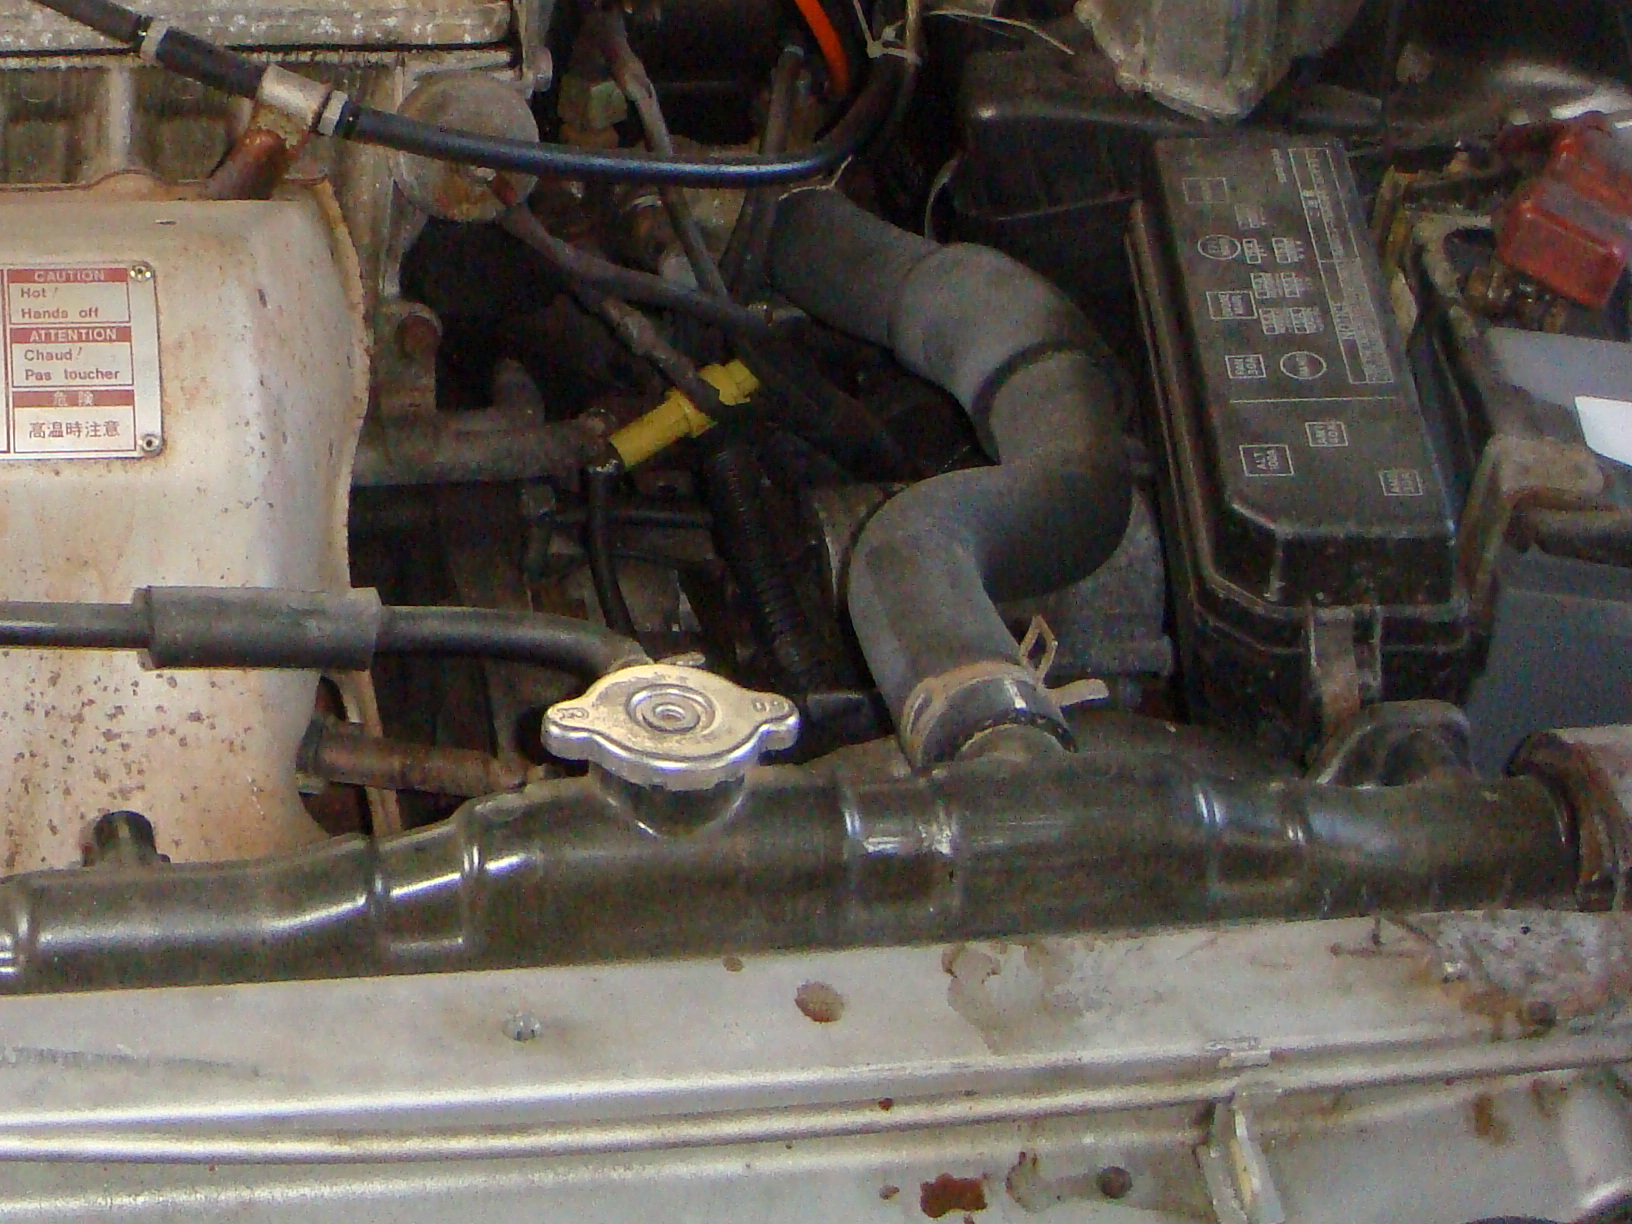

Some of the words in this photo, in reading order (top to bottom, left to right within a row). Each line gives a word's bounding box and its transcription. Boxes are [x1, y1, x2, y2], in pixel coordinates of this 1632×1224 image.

[34, 268, 106, 282] CAUTION
[20, 307, 69, 319] Hands
[78, 307, 100, 319] off
[29, 327, 118, 342] ATTENTION
[24, 368, 52, 381] Pas
[64, 368, 120, 381] toucher
[28, 420, 122, 439] 高温時注意
